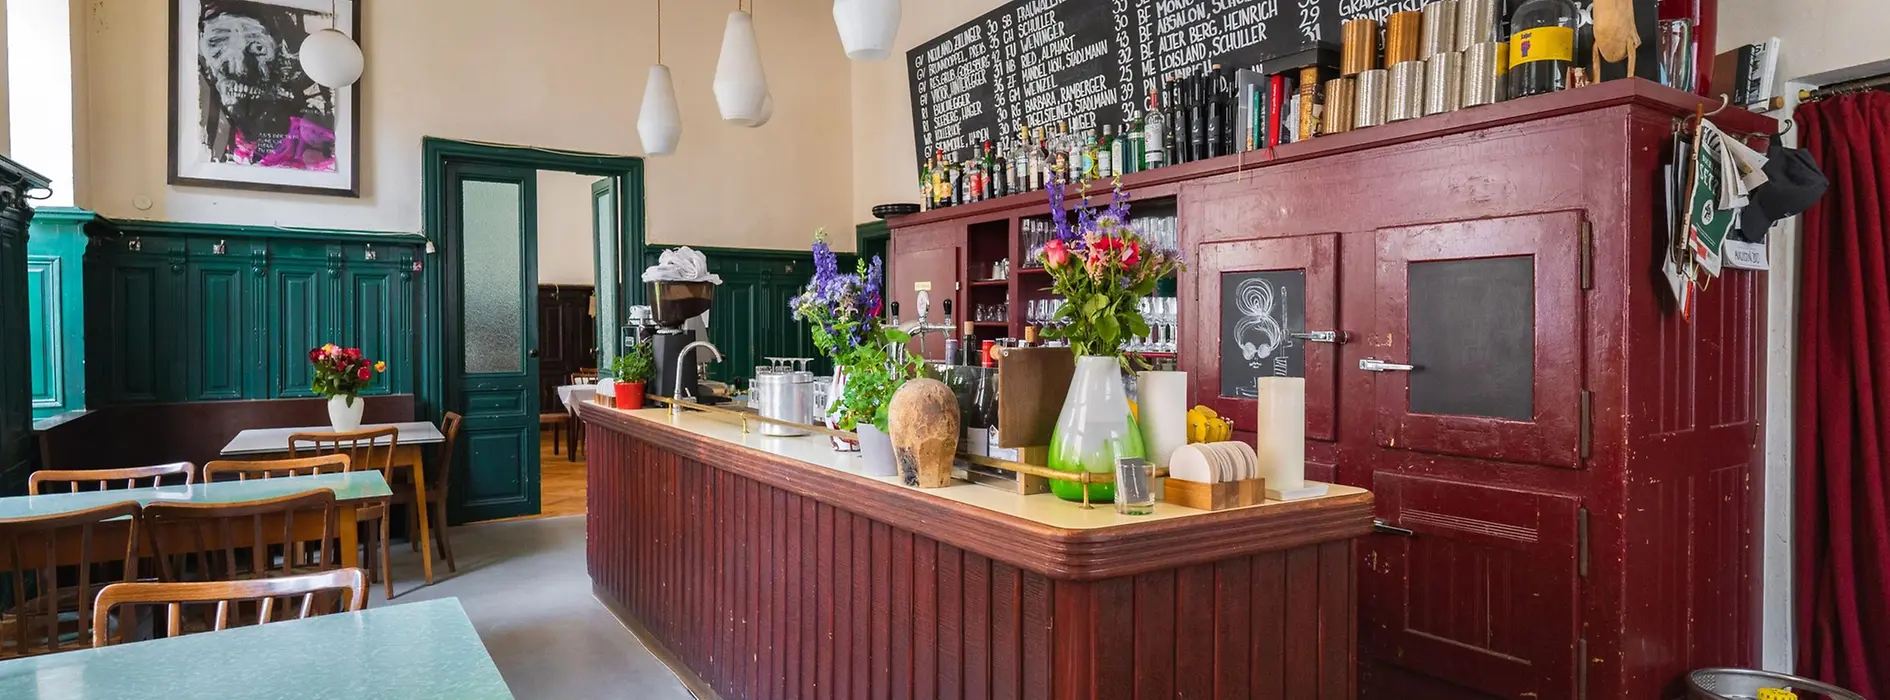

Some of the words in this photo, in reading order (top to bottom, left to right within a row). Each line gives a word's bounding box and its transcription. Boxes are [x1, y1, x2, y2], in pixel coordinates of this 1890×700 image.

[986, 19, 998, 36] 30
[1002, 13, 1012, 29] SB
[1002, 28, 1014, 44] CH
[1017, 10, 1056, 39] SCHULLER
[1041, 34, 1076, 61] ALPHART
[1114, 13, 1128, 31] 30
[1158, 30, 1187, 55] ALTER
[1223, 0, 1278, 31] HEINRICH
[1005, 42, 1017, 60] FU
[1020, 21, 1065, 53] WENINGER
[1065, 39, 1108, 68] STADLMANN
[1115, 30, 1130, 49] 43
[1141, 58, 1156, 77] ME
[1212, 22, 1267, 56] SCHULLER
[1299, 5, 1320, 28] 29
[993, 78, 1004, 93] 36
[1023, 74, 1058, 98] WENZEL
[1118, 46, 1133, 65] 32
[1143, 77, 1156, 96] PN
[994, 92, 1006, 108] 36
[1010, 102, 1021, 119] RG
[1060, 74, 1107, 103] RAMBERGER
[1119, 63, 1133, 83] 25
[1012, 117, 1022, 132] RG
[1075, 87, 1118, 113] STADLMANN
[1120, 82, 1134, 102] 39
[996, 107, 1008, 123] 30
[998, 121, 1010, 136] 30
[1122, 101, 1135, 123] 32
